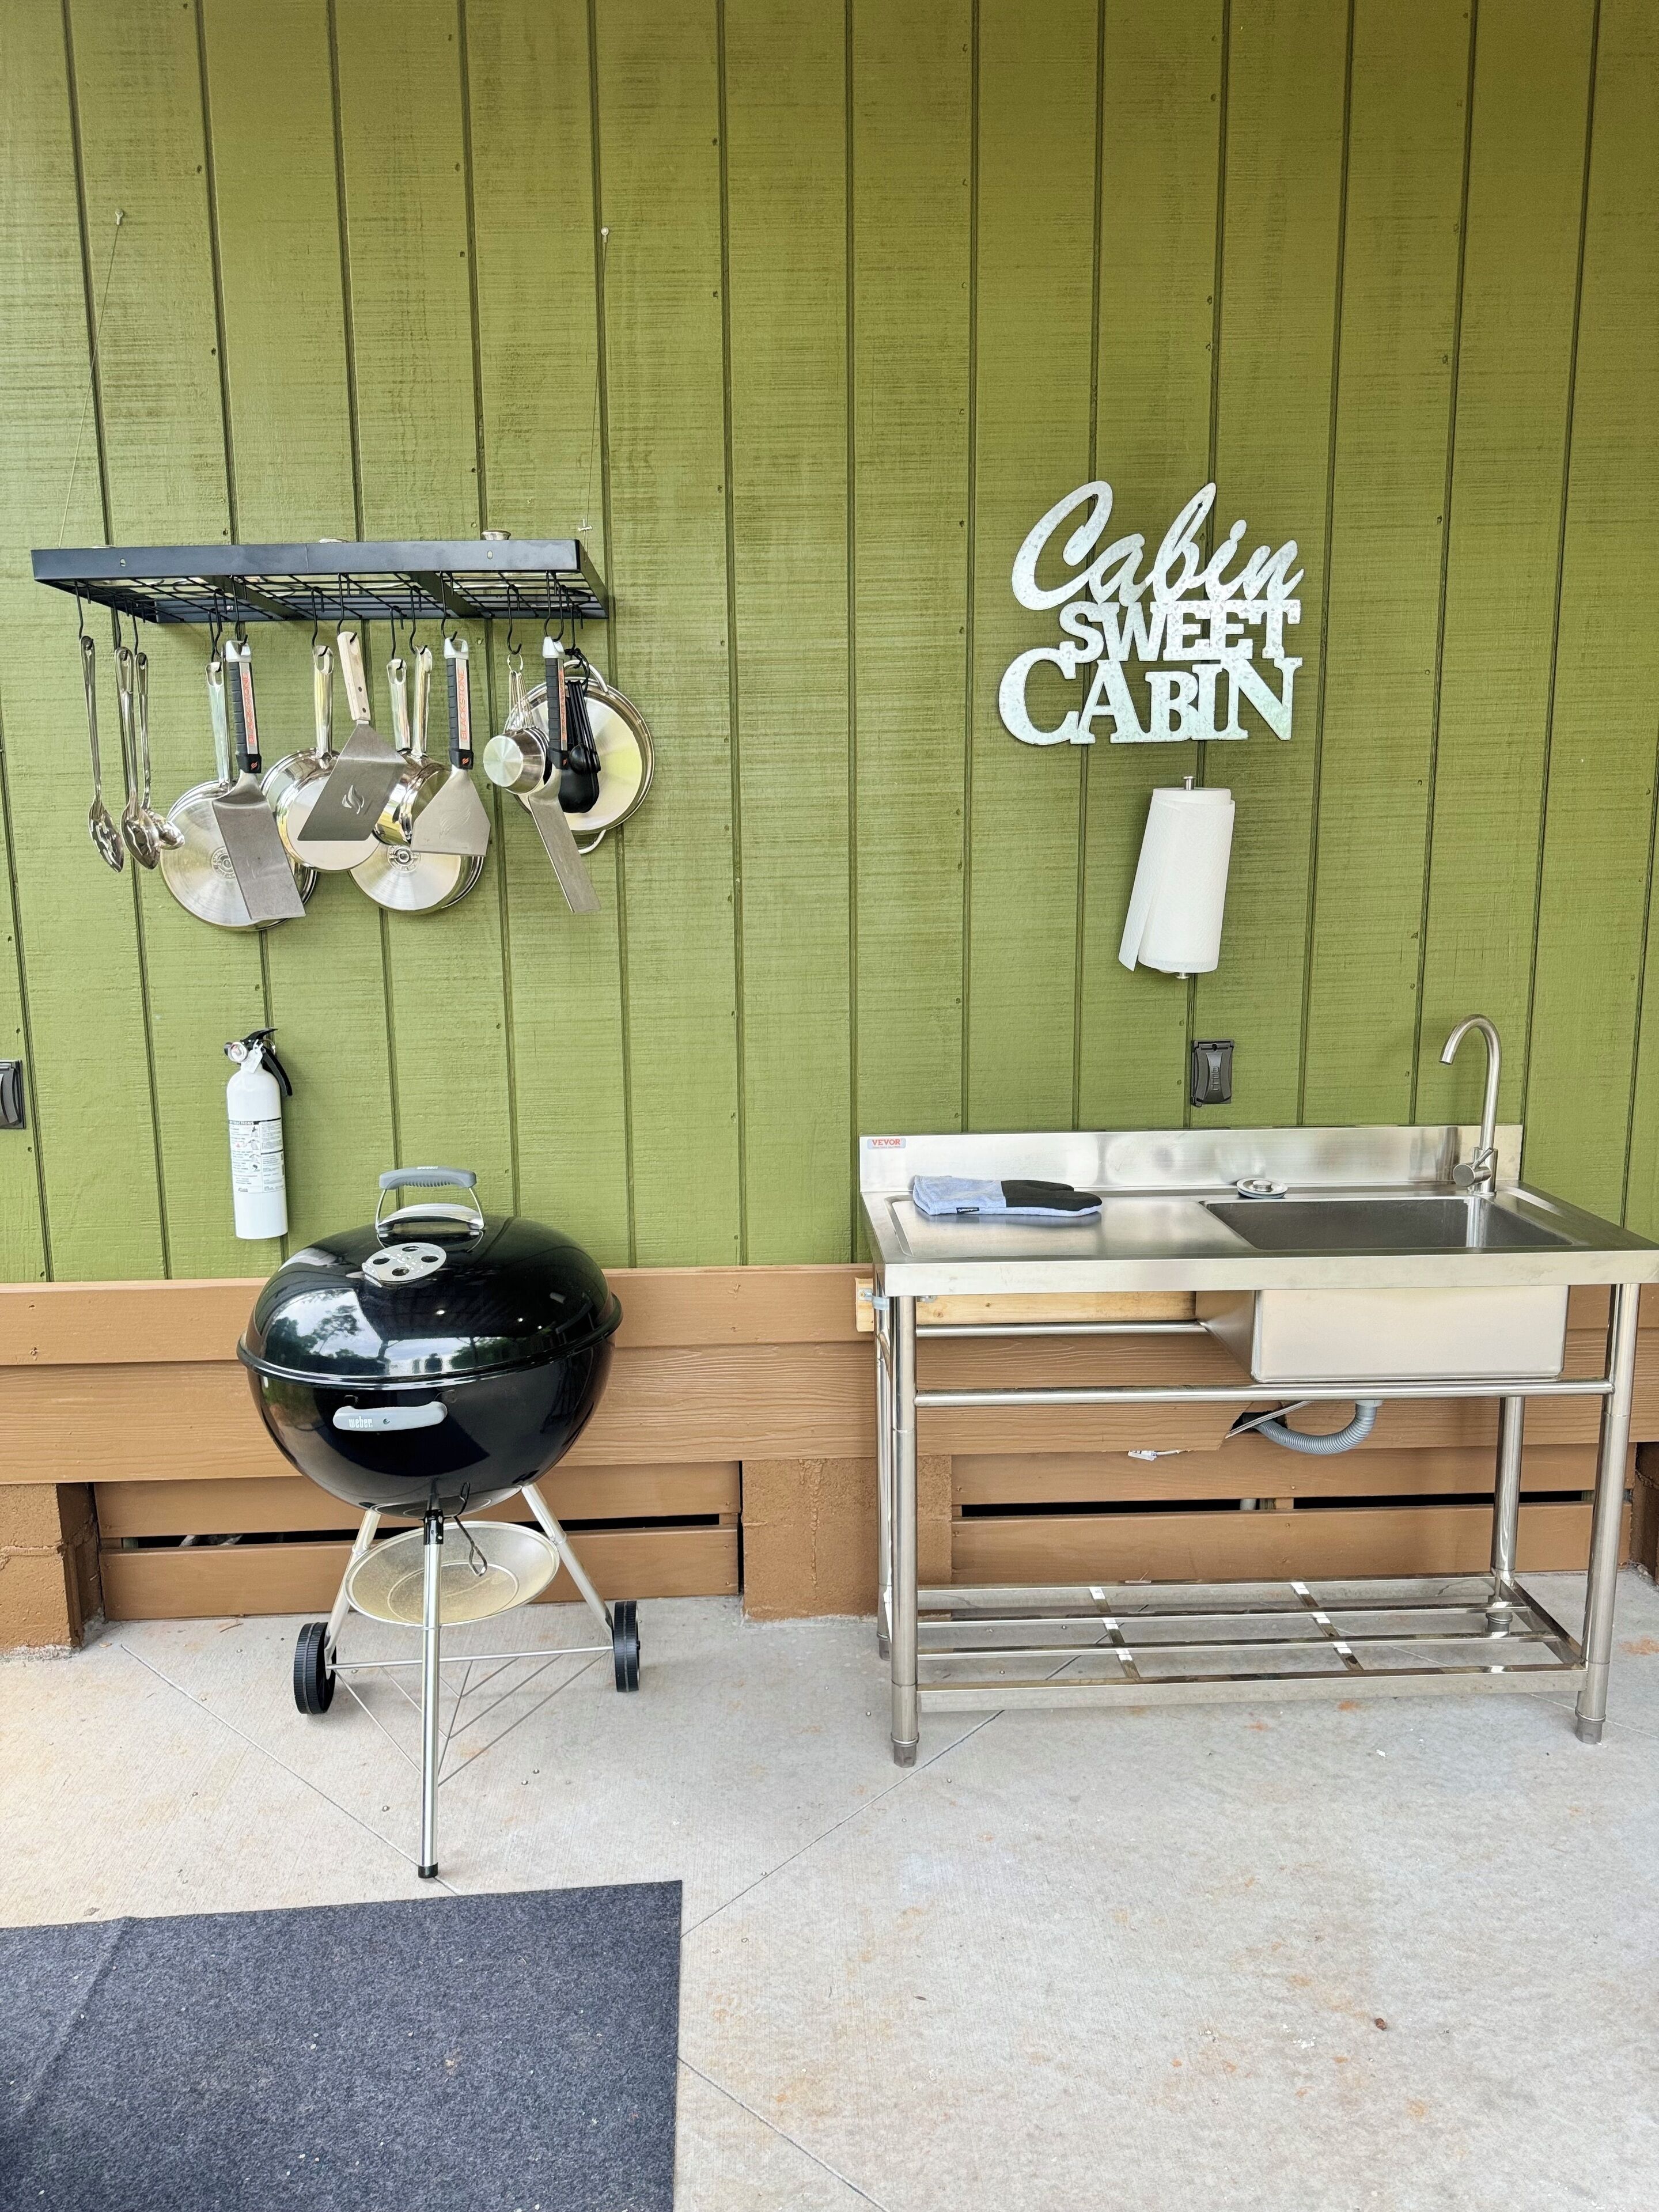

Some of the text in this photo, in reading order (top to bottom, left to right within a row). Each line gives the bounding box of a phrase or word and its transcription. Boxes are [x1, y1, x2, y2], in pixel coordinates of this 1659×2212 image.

[1012, 480, 1304, 611] Cabin
[1059, 599, 1301, 664] SWEET
[243, 672, 255, 743] BLACKSTONE
[457, 667, 468, 741] BLACKSTONE
[998, 657, 1302, 745] CABIN
[1211, 1066, 1219, 1091] BELL
